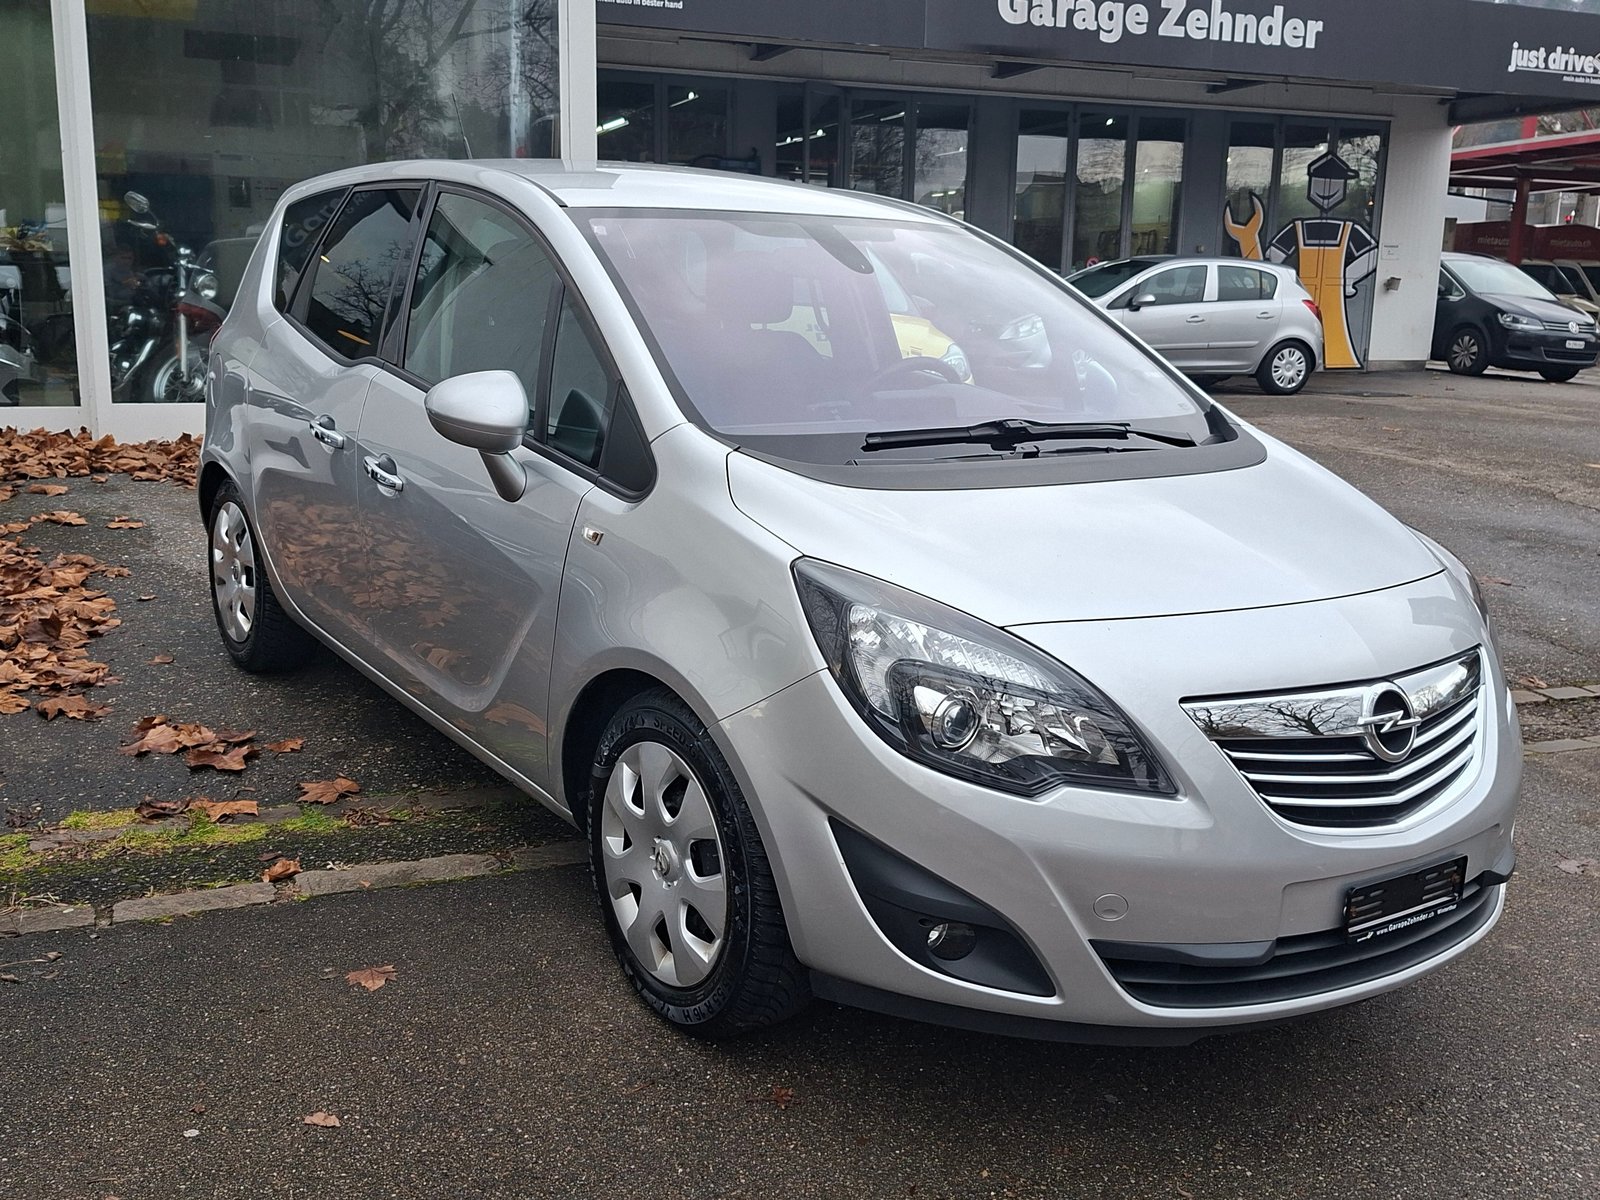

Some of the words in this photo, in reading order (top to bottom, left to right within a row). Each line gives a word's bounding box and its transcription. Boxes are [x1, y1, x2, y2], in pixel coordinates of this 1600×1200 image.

[664, 0, 683, 9] hand
[997, 0, 1149, 43] Garage
[1158, 0, 1323, 49] Zehnder
[1507, 41, 1546, 72] just
[1376, 911, 1435, 936] www.GarageZehnder.ch
